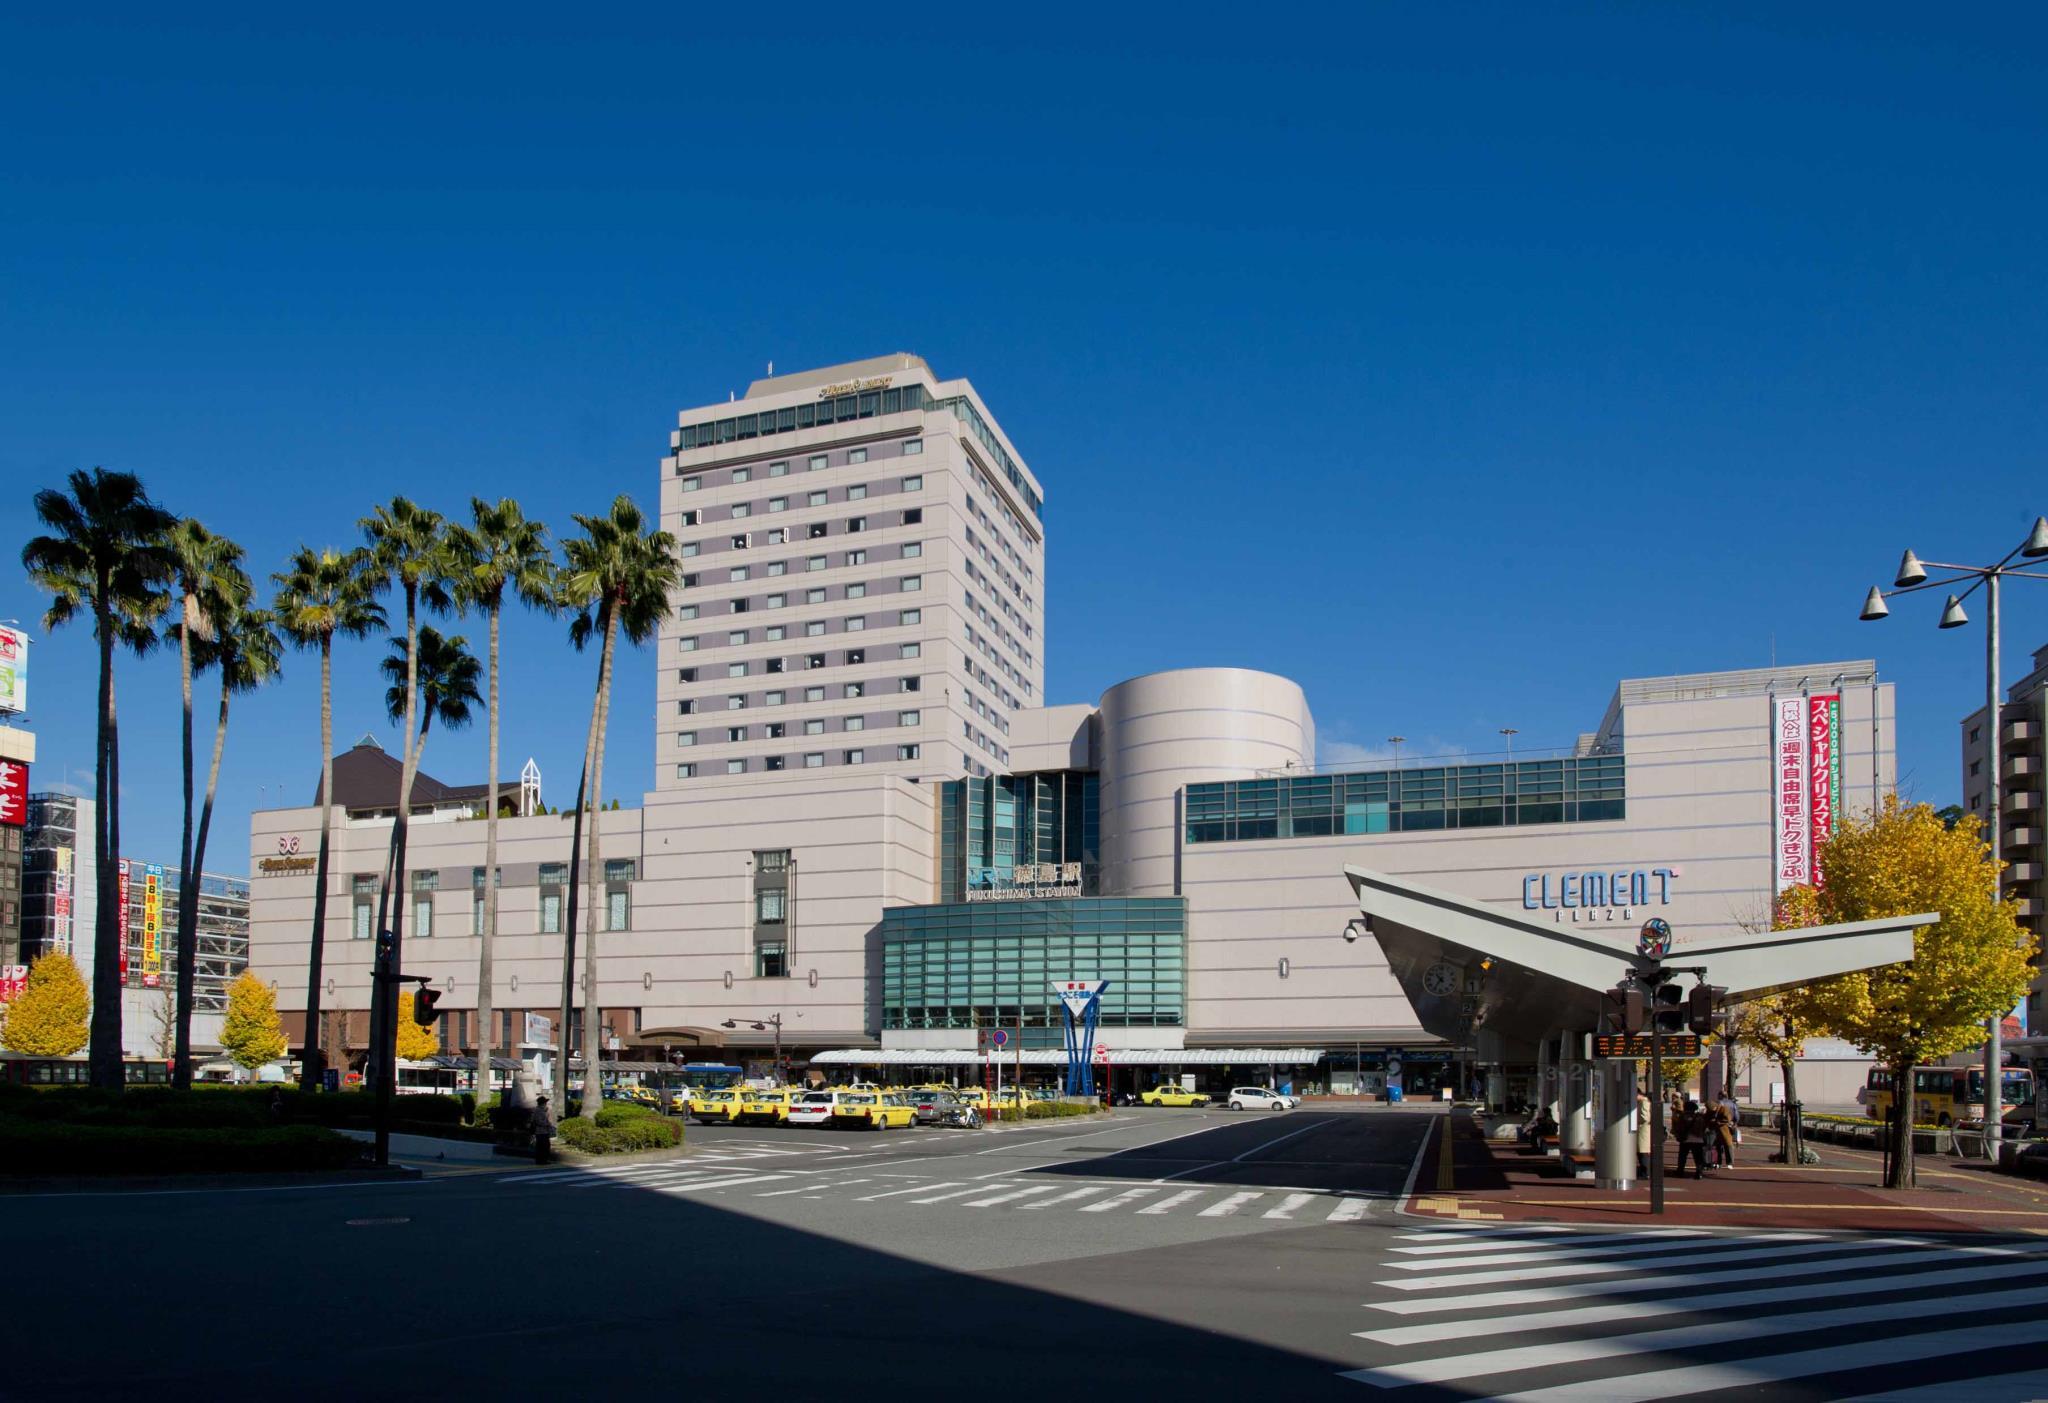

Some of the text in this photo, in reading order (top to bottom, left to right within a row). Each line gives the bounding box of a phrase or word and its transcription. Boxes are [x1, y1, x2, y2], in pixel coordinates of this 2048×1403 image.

[966, 885, 1082, 902] TOKUSHIMA STATION
[1523, 867, 1674, 910] CLEMENT
[1556, 907, 1633, 922] PLAZA
[1569, 1063, 1583, 1081] 2
